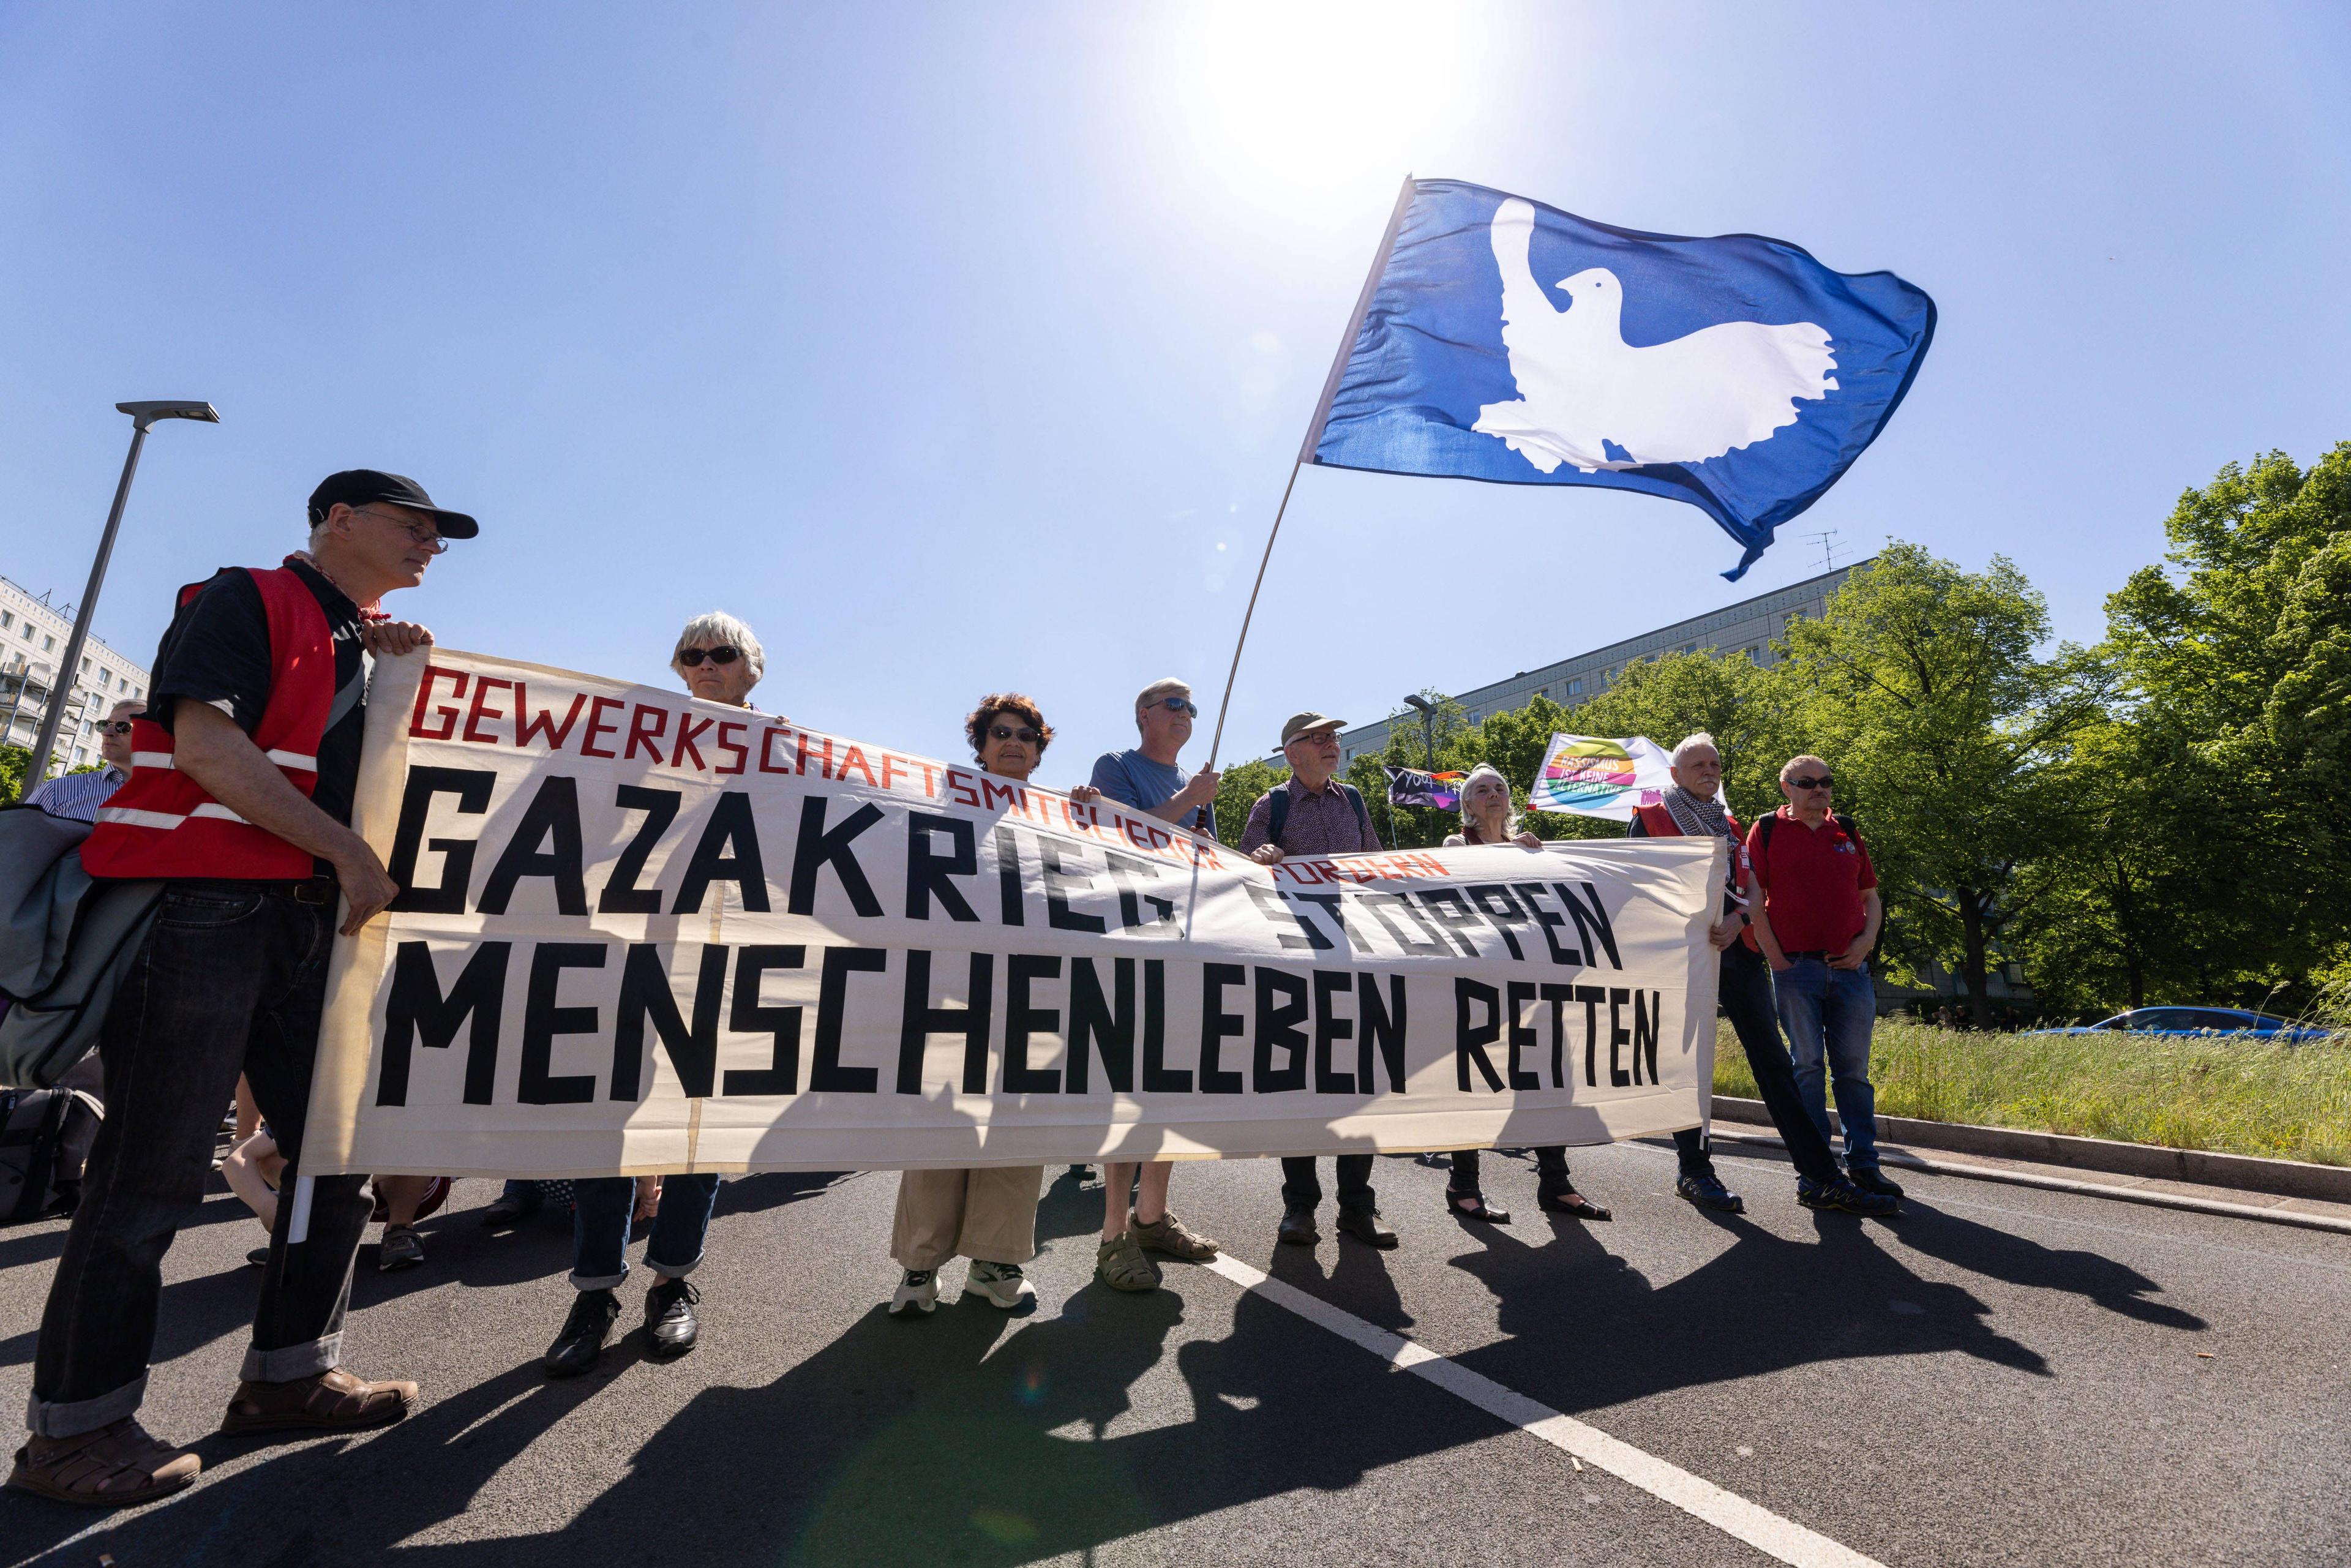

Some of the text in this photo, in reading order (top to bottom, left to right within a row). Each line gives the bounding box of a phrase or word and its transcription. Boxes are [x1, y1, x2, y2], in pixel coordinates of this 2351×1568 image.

[408, 664, 1228, 871] GEWERKSCHAFTSMITGLIEDER
[1553, 780, 1622, 795] ALTERNATIVE
[1559, 768, 1610, 784] IST KEINE
[1561, 756, 1619, 771] RASSISMUS
[384, 765, 1623, 970] GAZAKRIEG STOPPEN
[375, 940, 1660, 1107] MENSCHENLEBEN RETTEN
